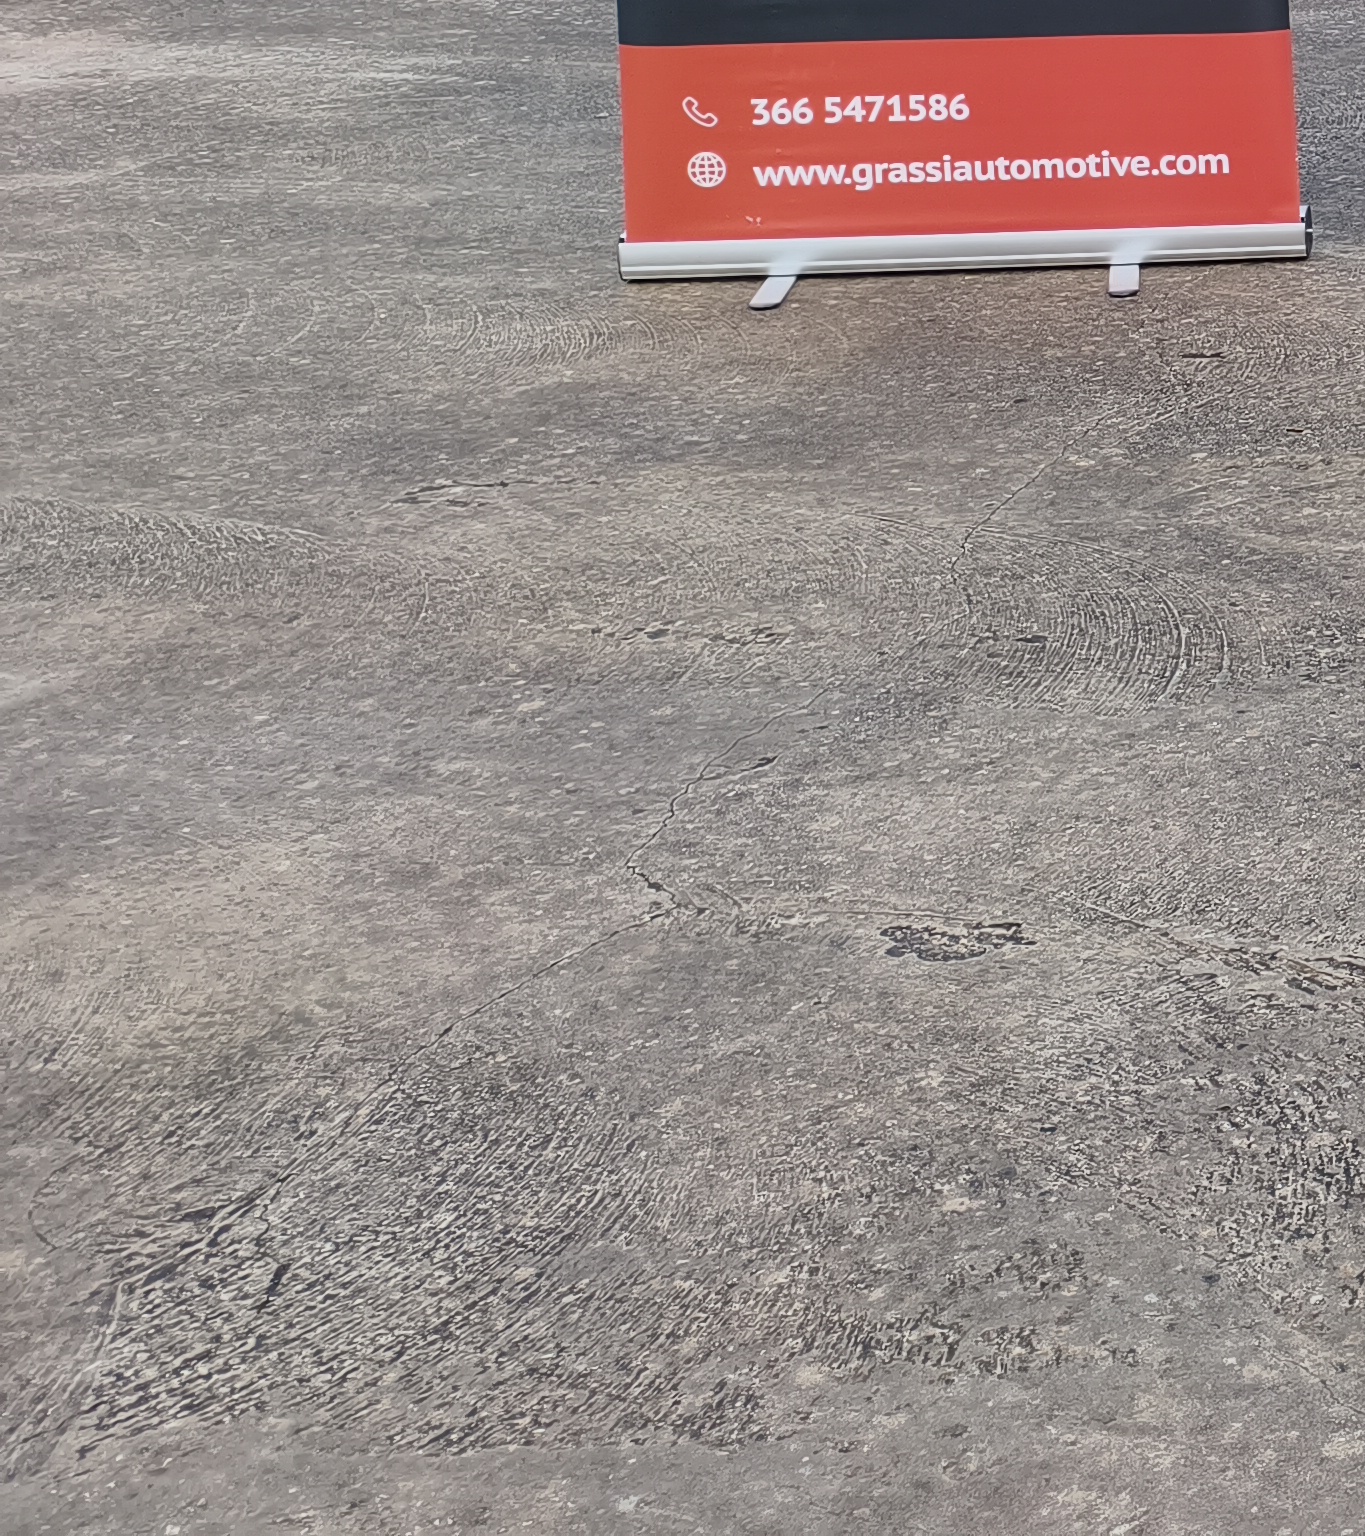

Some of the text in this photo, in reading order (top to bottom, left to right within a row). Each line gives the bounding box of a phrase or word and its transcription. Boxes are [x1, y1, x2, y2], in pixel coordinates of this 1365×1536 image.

[750, 93, 970, 126] 366 5471586
[752, 149, 1230, 191] www.grassiautomotive.com
